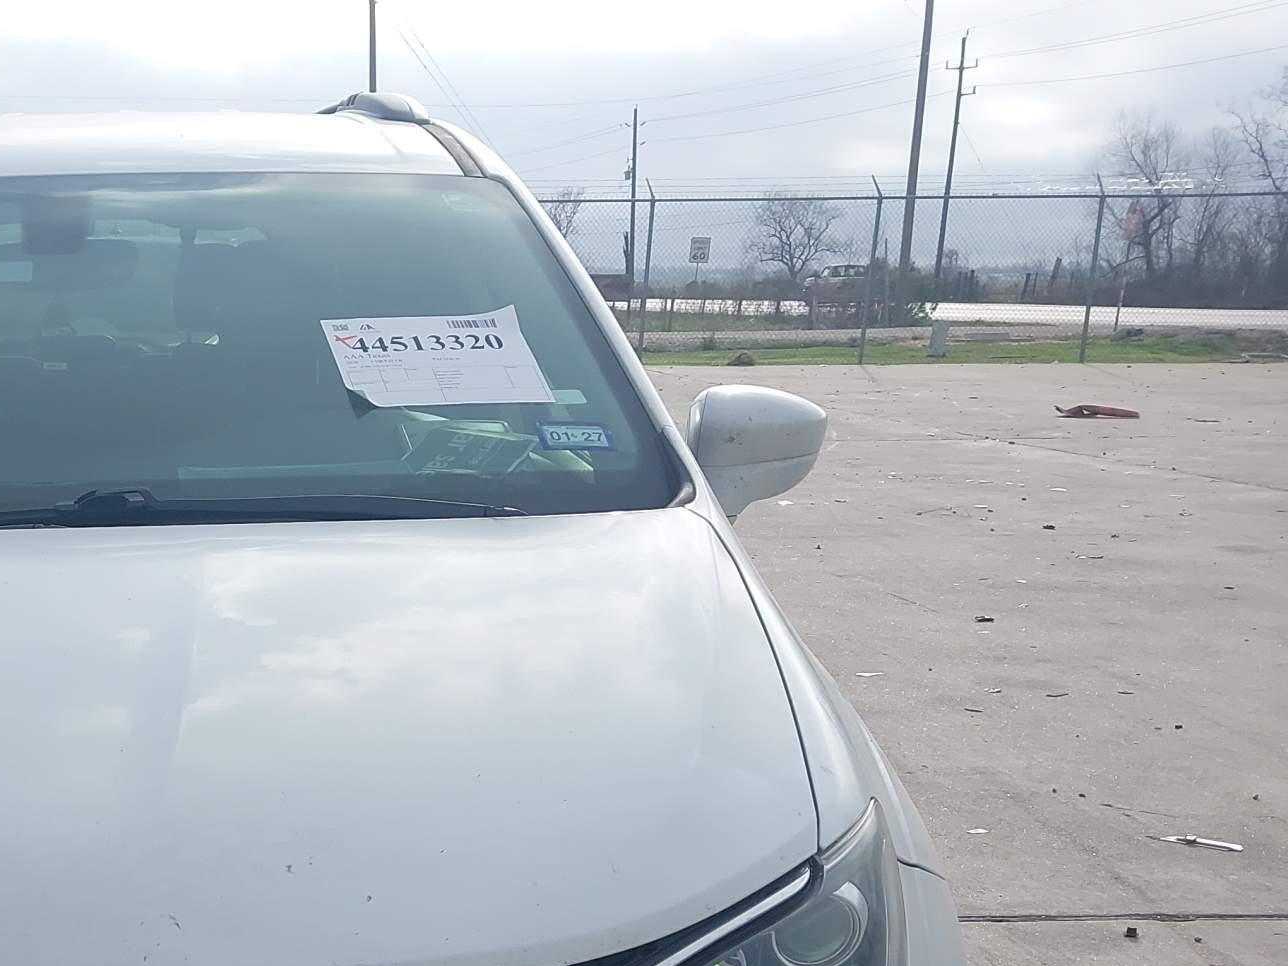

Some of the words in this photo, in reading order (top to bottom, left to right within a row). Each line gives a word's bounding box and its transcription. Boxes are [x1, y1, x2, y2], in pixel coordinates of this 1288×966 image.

[692, 251, 706, 261] 60
[352, 333, 504, 353] 44513320
[550, 431, 571, 441] 01
[581, 431, 602, 442] 27
